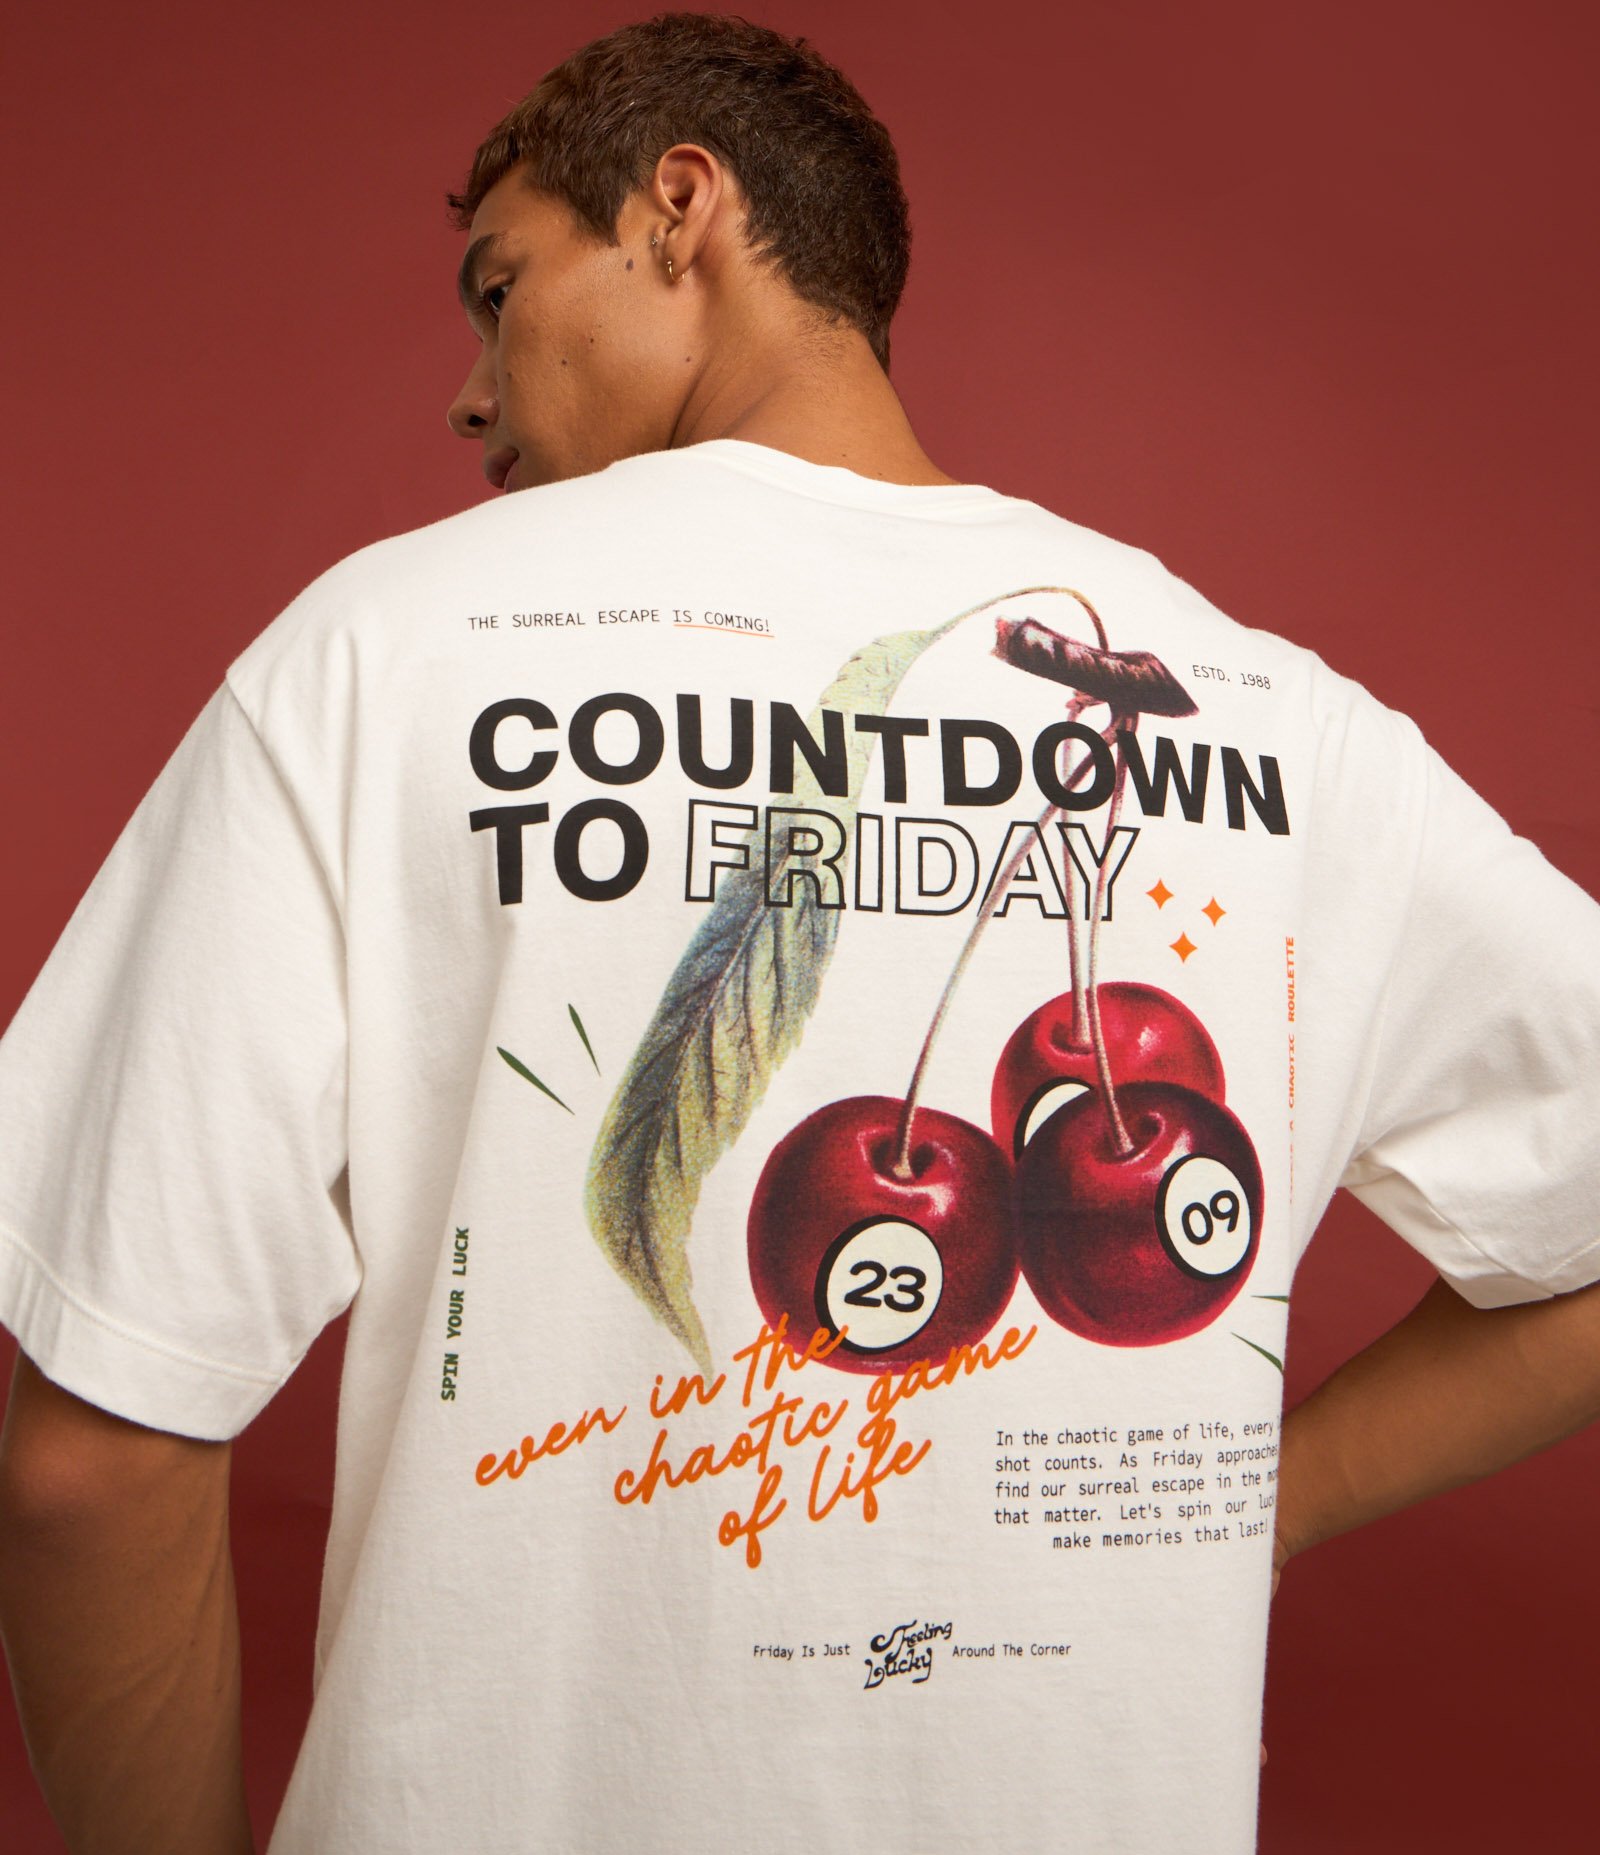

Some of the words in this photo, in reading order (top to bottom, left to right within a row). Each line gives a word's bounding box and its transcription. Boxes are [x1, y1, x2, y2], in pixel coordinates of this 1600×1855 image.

[468, 616, 499, 630] THE
[512, 612, 586, 628] SURREAL
[598, 610, 660, 624] ESCAPE
[673, 610, 692, 623] IS
[704, 611, 769, 632] COMING!
[1192, 665, 1230, 682] ESTD.
[1241, 673, 1271, 690] 1988
[468, 692, 1291, 835] COUNTDOWN
[469, 798, 649, 905] TO
[685, 798, 1140, 921] FRIDAY
[1286, 936, 1296, 1023] ROULETTE
[1288, 1033, 1296, 1109] CHAOTIC
[1181, 1189, 1240, 1245] 09
[452, 1227, 470, 1276] LUCK
[844, 1261, 927, 1313] 23
[447, 1290, 465, 1339] YOUR
[441, 1353, 459, 1401] SPIN
[475, 1405, 627, 1486] even
[650, 1373, 727, 1418] in
[733, 1312, 850, 1408] the
[614, 1397, 849, 1505] chaotic
[857, 1324, 1038, 1447] game
[996, 1431, 1013, 1446] In
[1023, 1430, 1048, 1446] the
[1057, 1427, 1118, 1444] chaotic
[1128, 1427, 1164, 1446] game
[1173, 1424, 1190, 1440] of
[1200, 1423, 1234, 1441] life,
[1244, 1422, 1274, 1437] every
[996, 1456, 1030, 1472] shot
[1045, 1455, 1103, 1471] counts.
[1120, 1453, 1138, 1468] As
[1154, 1450, 1203, 1468] Friday
[996, 1481, 1030, 1498] find
[1041, 1483, 1066, 1497] our
[1079, 1477, 1140, 1495] surreal
[1152, 1477, 1204, 1494] escape
[1216, 1473, 1232, 1490] in
[1242, 1470, 1261, 1486] the
[718, 1464, 788, 1568] of
[808, 1419, 932, 1522] life
[994, 1508, 1029, 1525] that
[1044, 1507, 1102, 1523] matter.
[1120, 1503, 1162, 1520] Let's
[1178, 1501, 1212, 1518] spin
[1225, 1499, 1247, 1514] our
[1053, 1532, 1091, 1550] make
[1102, 1528, 1182, 1548] memories
[1195, 1524, 1229, 1542] that
[1239, 1518, 1268, 1538] last!
[753, 1645, 794, 1661] Friday
[802, 1646, 815, 1658] Is
[824, 1643, 850, 1656] Just
[870, 1619, 952, 1664] Feeling
[952, 1644, 995, 1658] Around
[1003, 1643, 1023, 1656] The
[1030, 1643, 1072, 1656] Corner
[863, 1647, 932, 1690] Lucky
